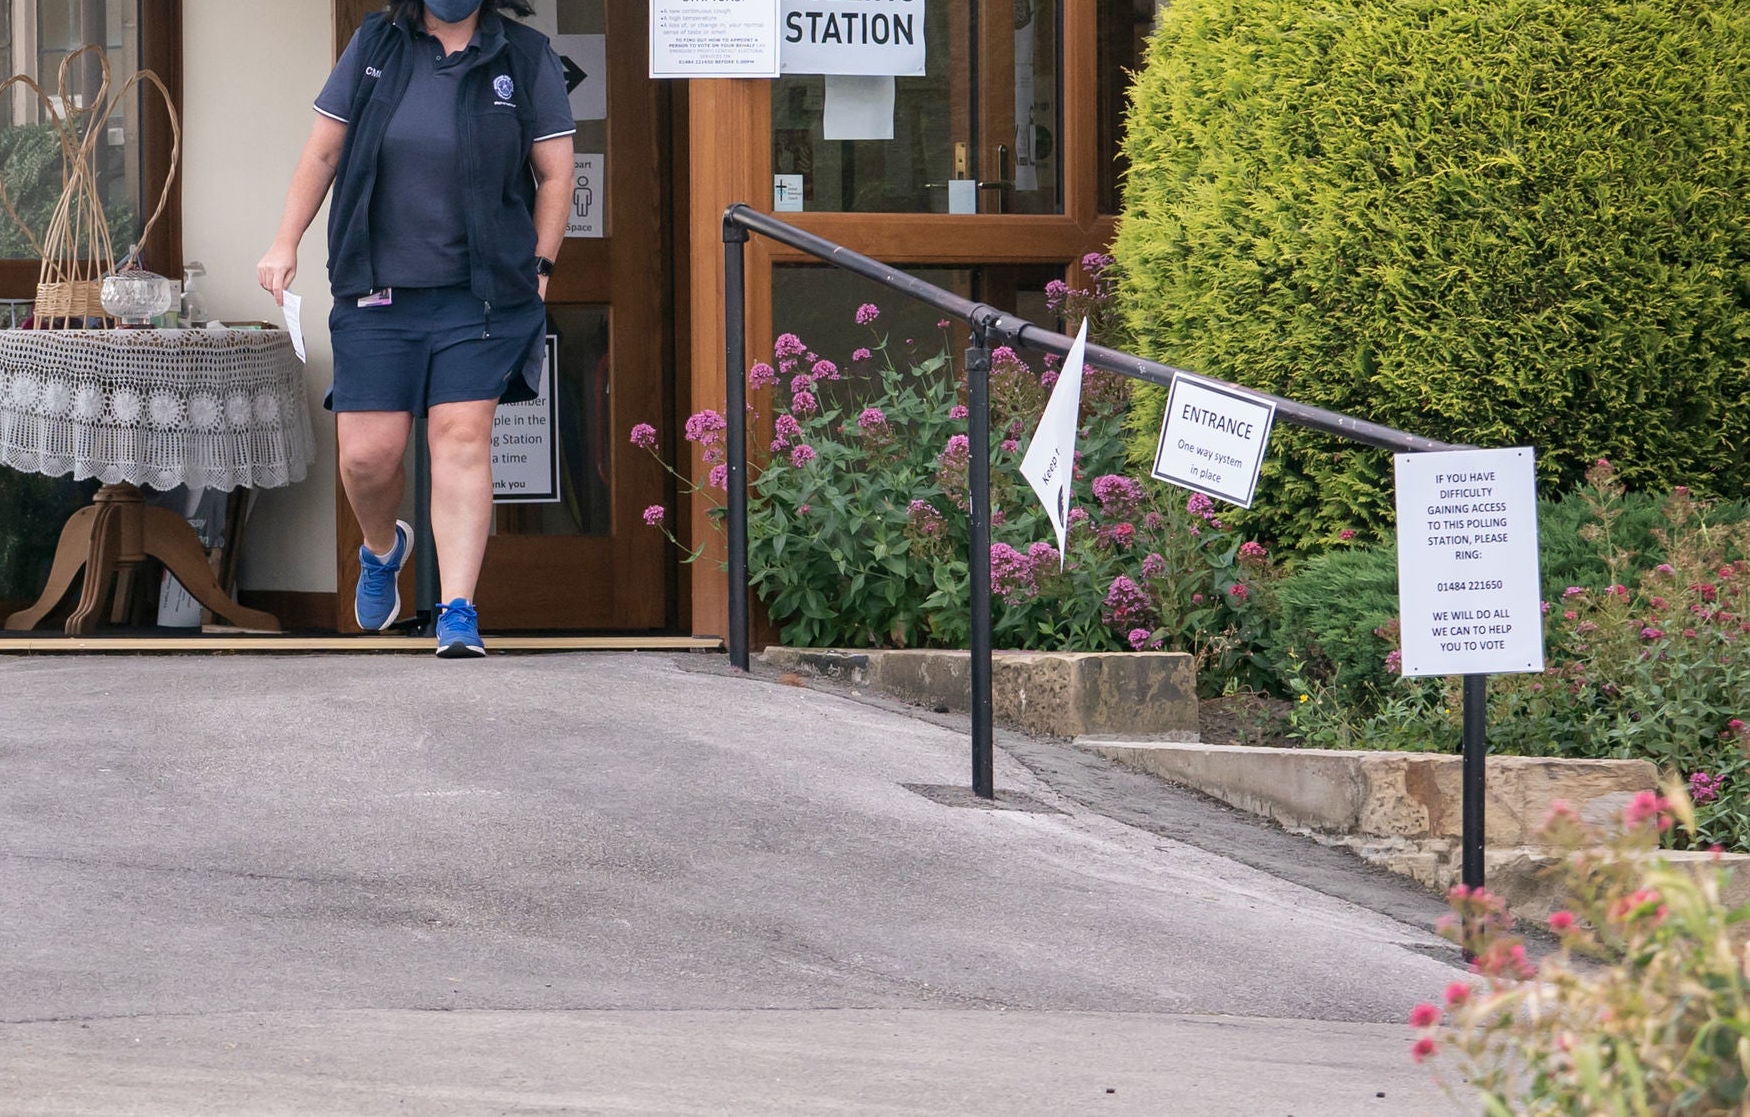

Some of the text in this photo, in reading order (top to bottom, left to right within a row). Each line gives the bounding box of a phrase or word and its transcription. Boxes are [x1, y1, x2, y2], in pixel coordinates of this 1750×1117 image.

[785, 11, 914, 45] STATION
[514, 415, 524, 425] in
[528, 414, 546, 425] the
[1182, 404, 1253, 440] ENTRANCE
[503, 433, 542, 444] Station
[492, 453, 527, 463] a time
[1178, 439, 1243, 468] One way system
[1042, 456, 1058, 486] Keep
[1190, 464, 1222, 483] in place
[1435, 472, 1495, 483] IF YOU HAVE
[508, 481, 526, 490] you
[1439, 488, 1492, 499] DIFFICULTY
[1427, 502, 1506, 515] GAINING ACCESS
[1428, 518, 1507, 530] TO THIS POLLING
[1428, 533, 1508, 546] STATION, PLEASE
[1455, 550, 1482, 560] RING:
[1437, 580, 1503, 592] 01484 221650
[1433, 609, 1510, 621] WE WILL DO ALL
[1432, 624, 1512, 636] WE CAN TO HELP
[1440, 640, 1505, 652] YOU TO VOTE
